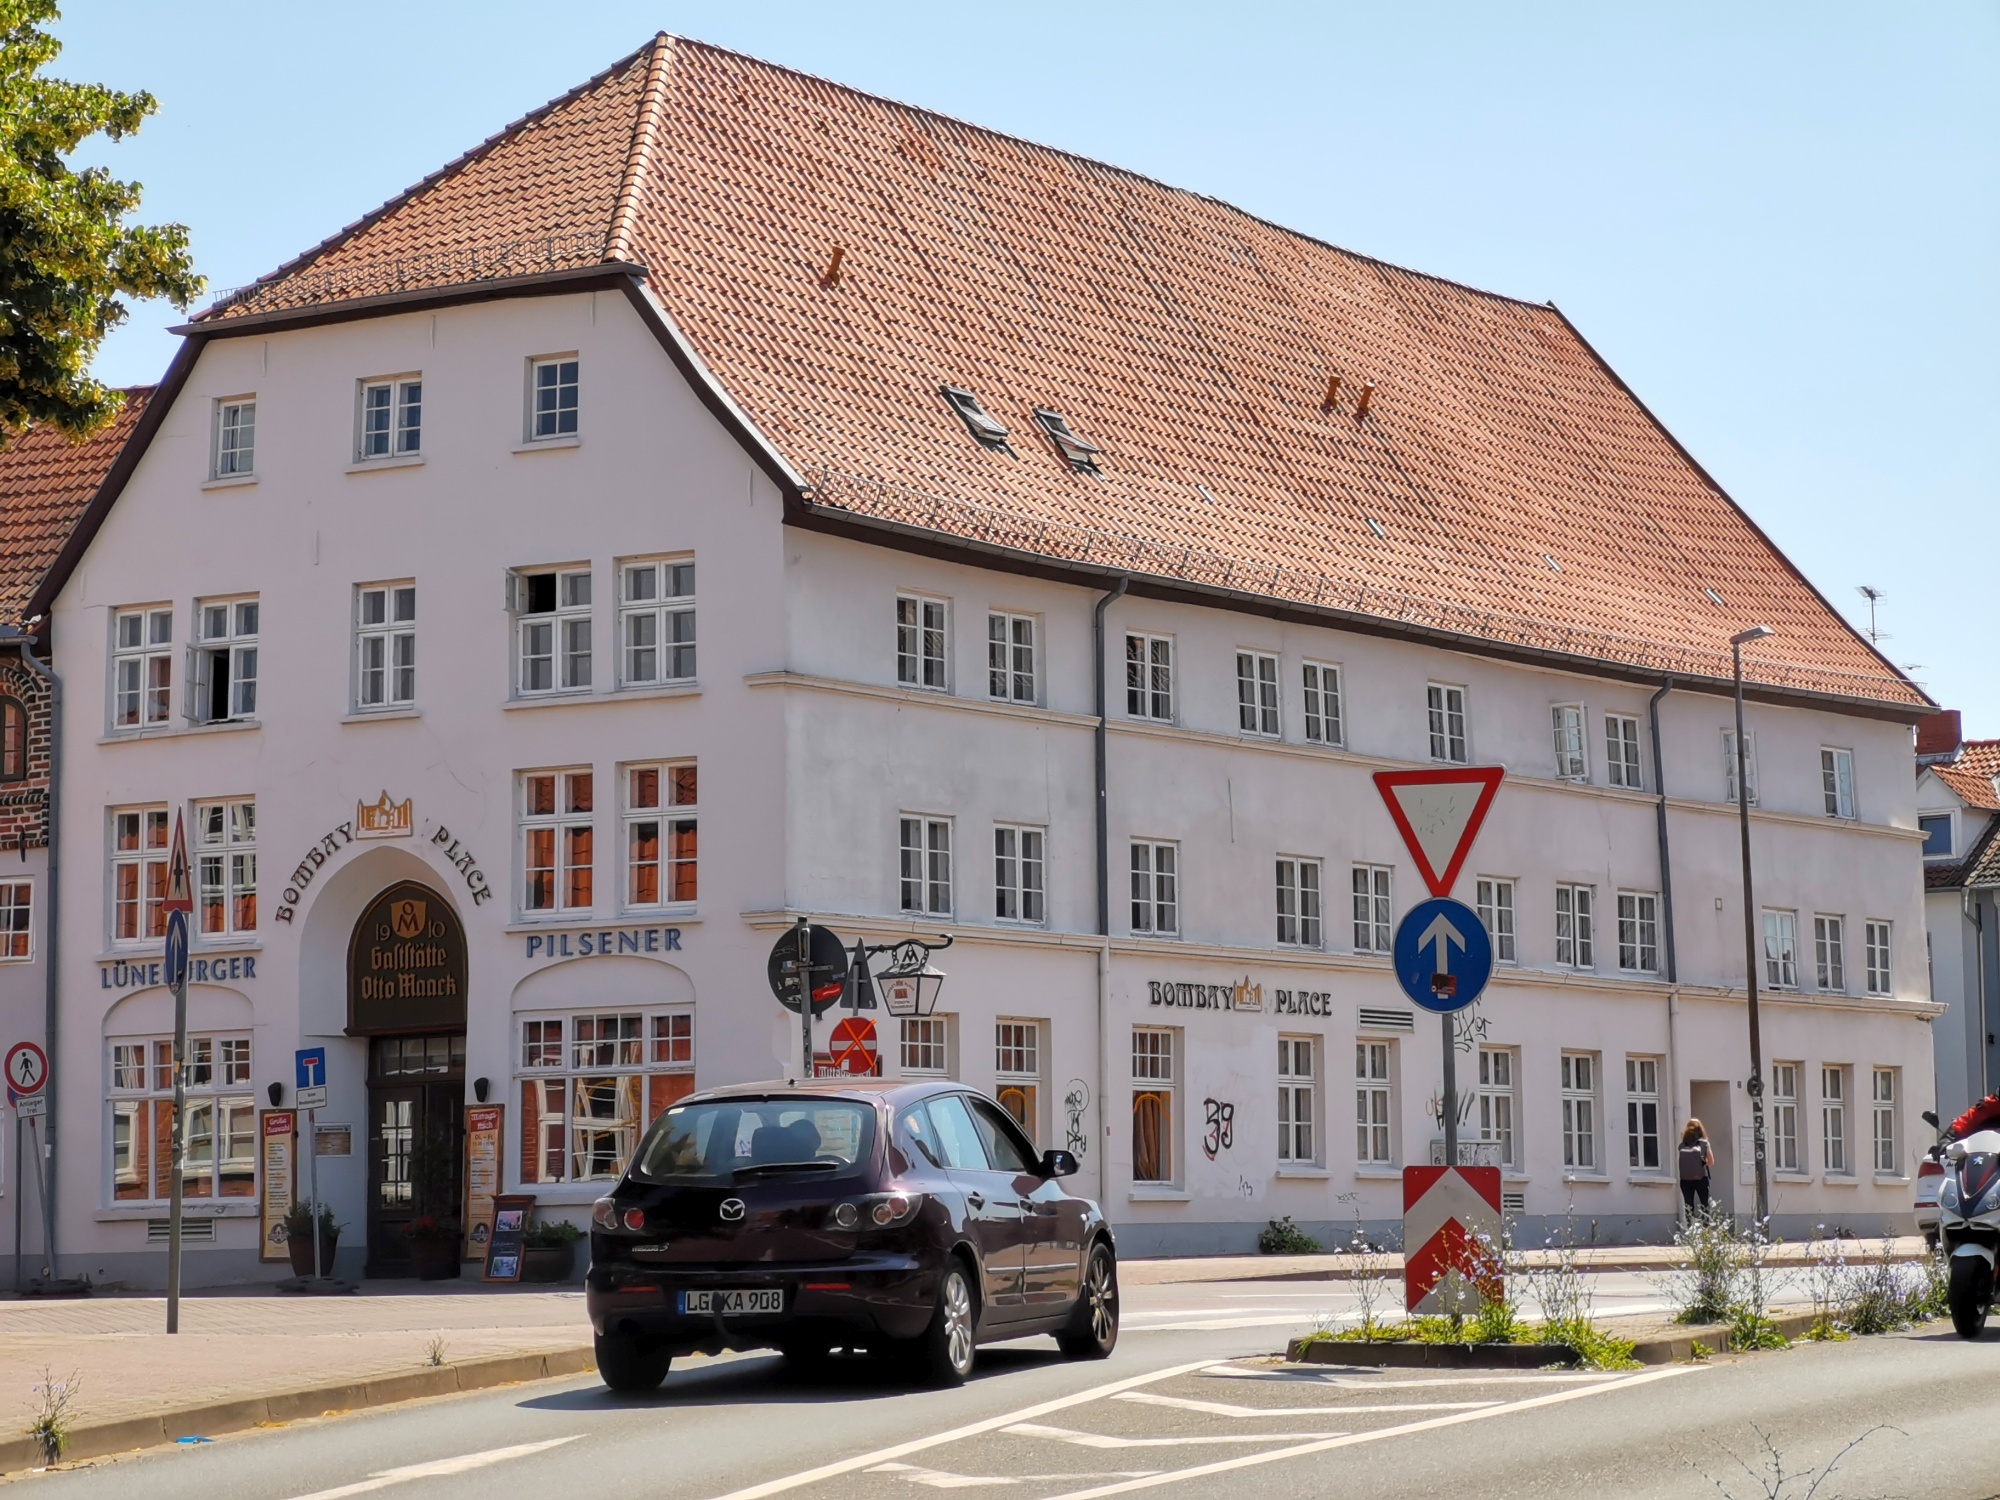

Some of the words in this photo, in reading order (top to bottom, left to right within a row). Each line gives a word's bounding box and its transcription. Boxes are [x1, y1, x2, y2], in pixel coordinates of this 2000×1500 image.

[275, 821, 352, 925] BOMBAY
[430, 825, 492, 906] PLACE
[526, 928, 682, 958] PILSENER
[361, 975, 395, 1000] Otto
[398, 972, 456, 998] Maack
[1148, 981, 1233, 1010] BOMBAY
[1274, 989, 1332, 1017] PLACE
[687, 1292, 710, 1313] LG
[721, 1292, 744, 1312] KA
[748, 1291, 781, 1311] 908
